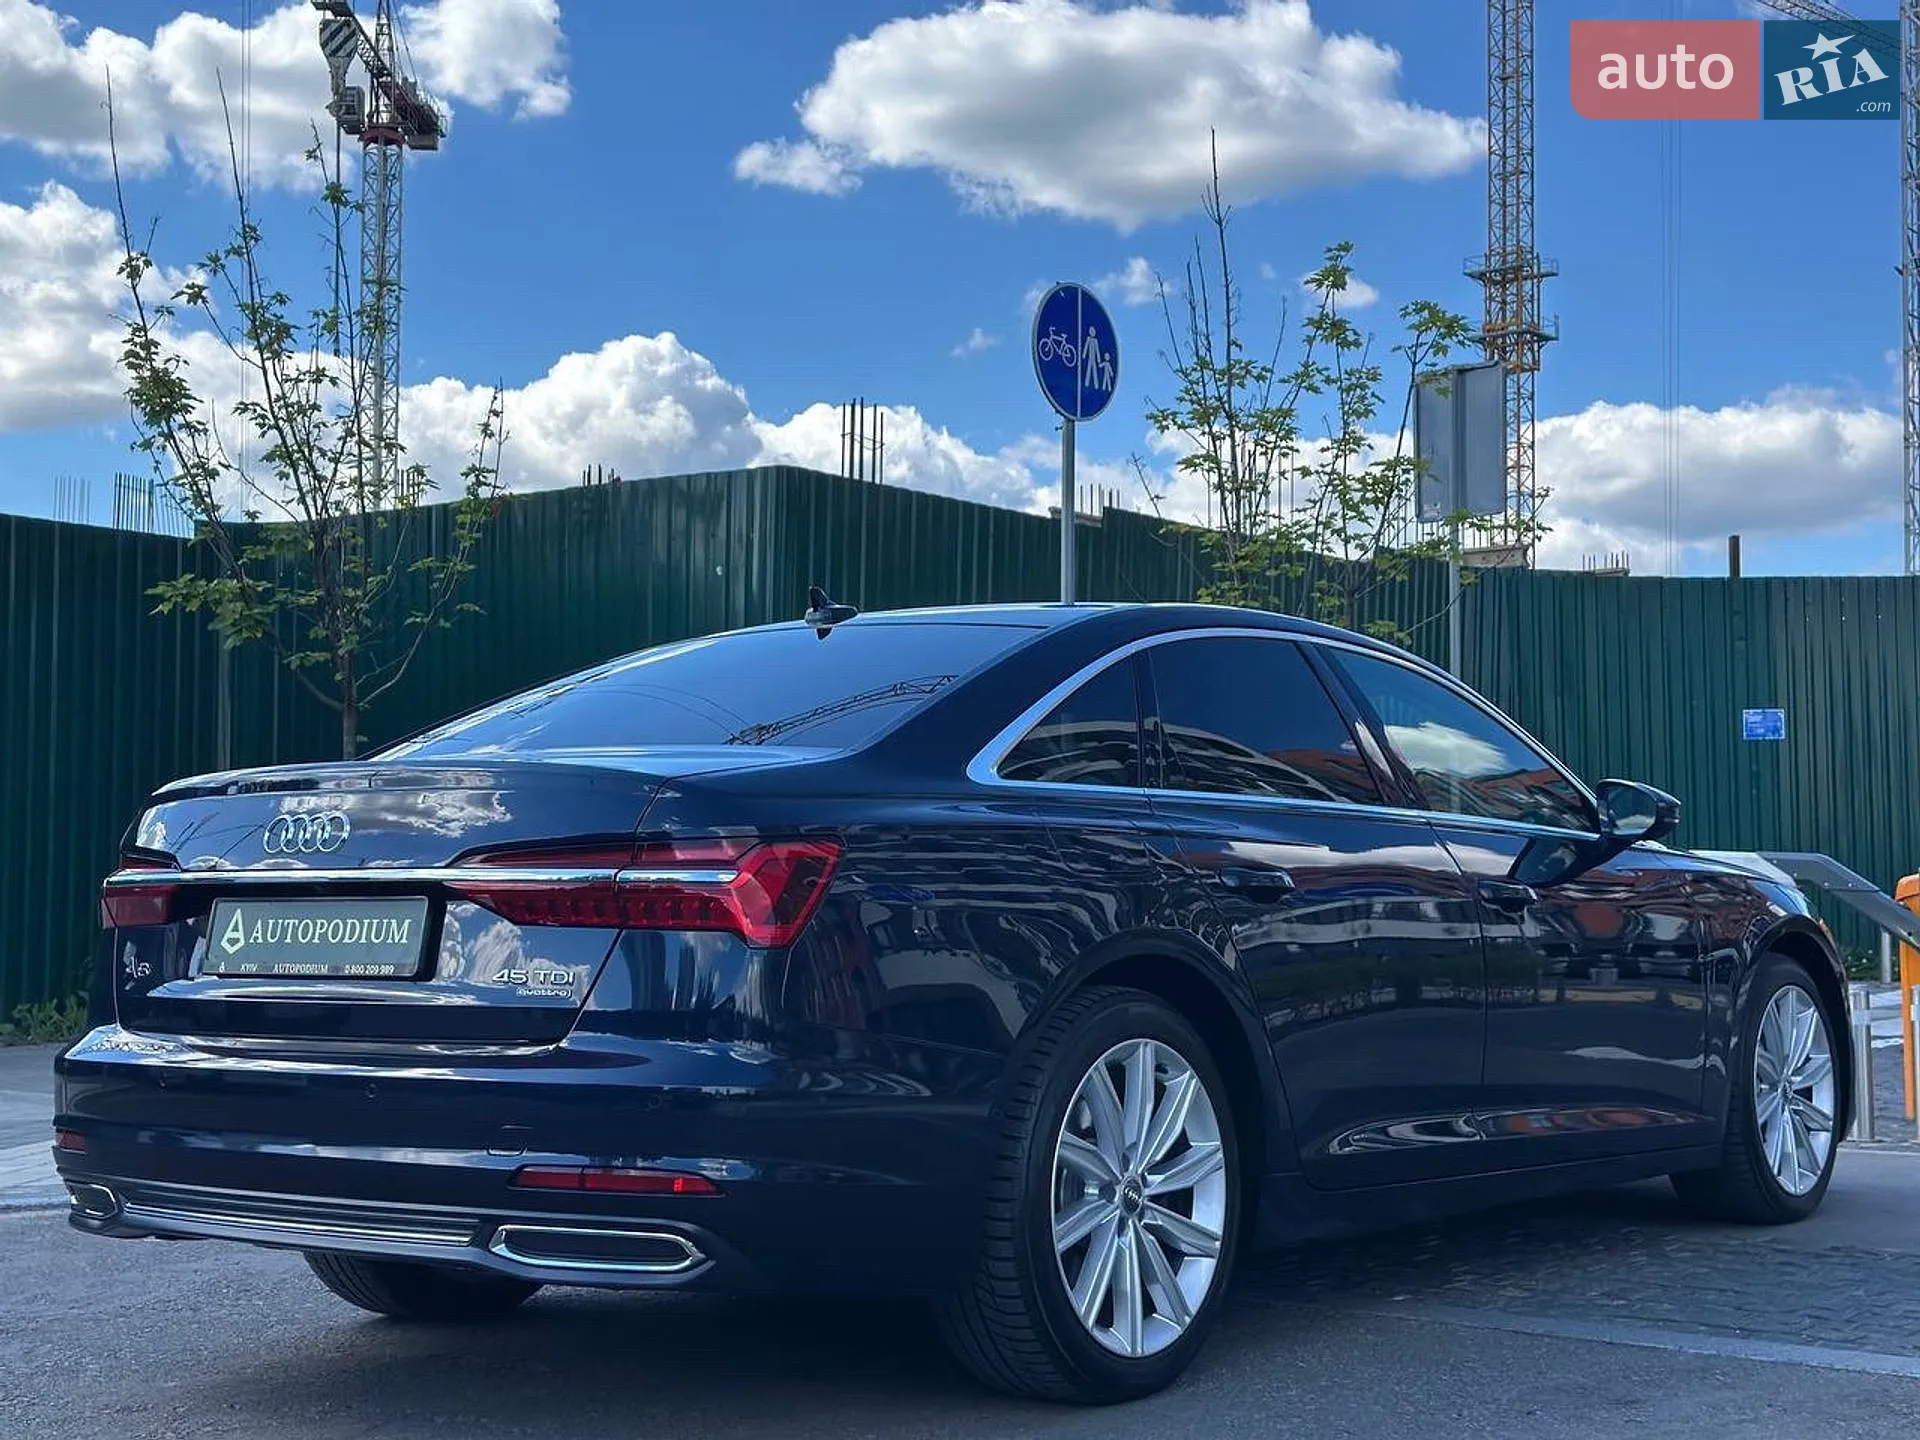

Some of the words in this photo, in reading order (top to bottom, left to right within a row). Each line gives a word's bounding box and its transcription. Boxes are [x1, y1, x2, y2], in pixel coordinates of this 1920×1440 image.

[248, 917, 412, 944] AUTOPODIUM
[272, 963, 329, 974] AUTOPODIUM
[492, 968, 528, 985] 45
[534, 969, 574, 986] TDI
[517, 987, 572, 998] quattro
